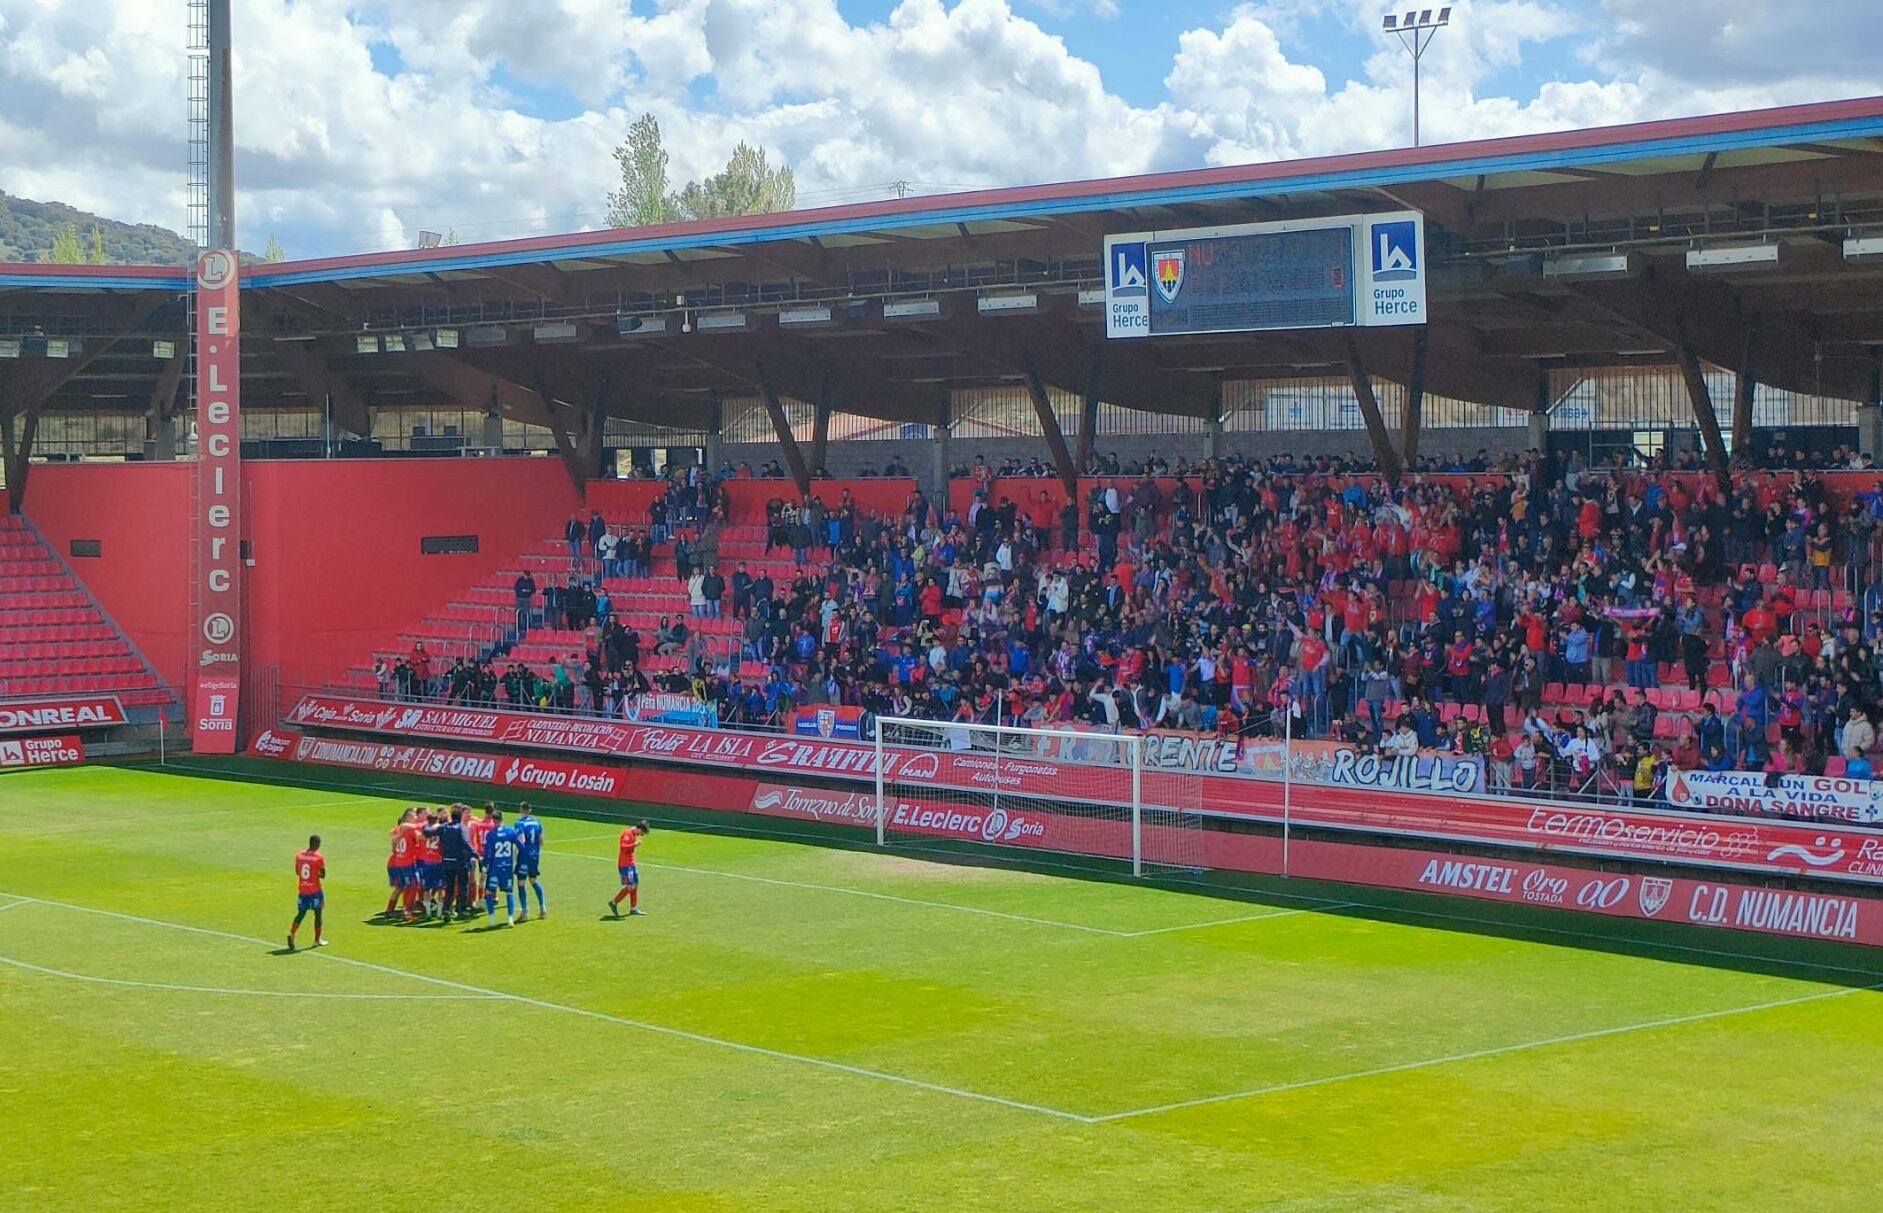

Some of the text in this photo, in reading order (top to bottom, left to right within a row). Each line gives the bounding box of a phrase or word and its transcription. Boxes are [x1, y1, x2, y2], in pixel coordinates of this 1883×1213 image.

[1373, 288, 1404, 299] Grupo
[1112, 303, 1139, 313] Grupo
[1374, 300, 1418, 315] Herce
[1112, 314, 1148, 328] Herce
[656, 694, 691, 712] NUMANCIA
[314, 706, 336, 721] Caja
[348, 710, 375, 724] Soria
[422, 711, 498, 729] SAN MIGUEL
[199, 718, 233, 731] Soria
[25, 739, 62, 750] Grupo
[522, 728, 599, 748] NUMANCIA
[688, 734, 713, 753] LA
[713, 736, 753, 757] ISLA
[27, 748, 79, 764] Herce
[953, 756, 998, 770] Camiones
[1004, 762, 1058, 776] Furgonetas
[1331, 748, 1479, 793] ROJILLO
[520, 763, 614, 792] Grupo Losán
[1779, 779, 1804, 790] UN
[1813, 778, 1868, 795] GOL
[1727, 787, 1838, 803] A LA VIDA
[837, 793, 856, 817] de
[1704, 795, 1860, 820] DONA SANGRE
[893, 803, 1044, 841] E.Leclerc Soria
[1527, 806, 1719, 848] termoservicio
[529, 831, 535, 844] 1
[494, 841, 512, 858] 23
[301, 863, 311, 881] 6
[1419, 859, 1514, 894] AMSTEL
[1522, 868, 1568, 894] Oro
[1522, 890, 1563, 903] TOSTADA
[1689, 884, 1858, 938] C.D. NUMANCIA
